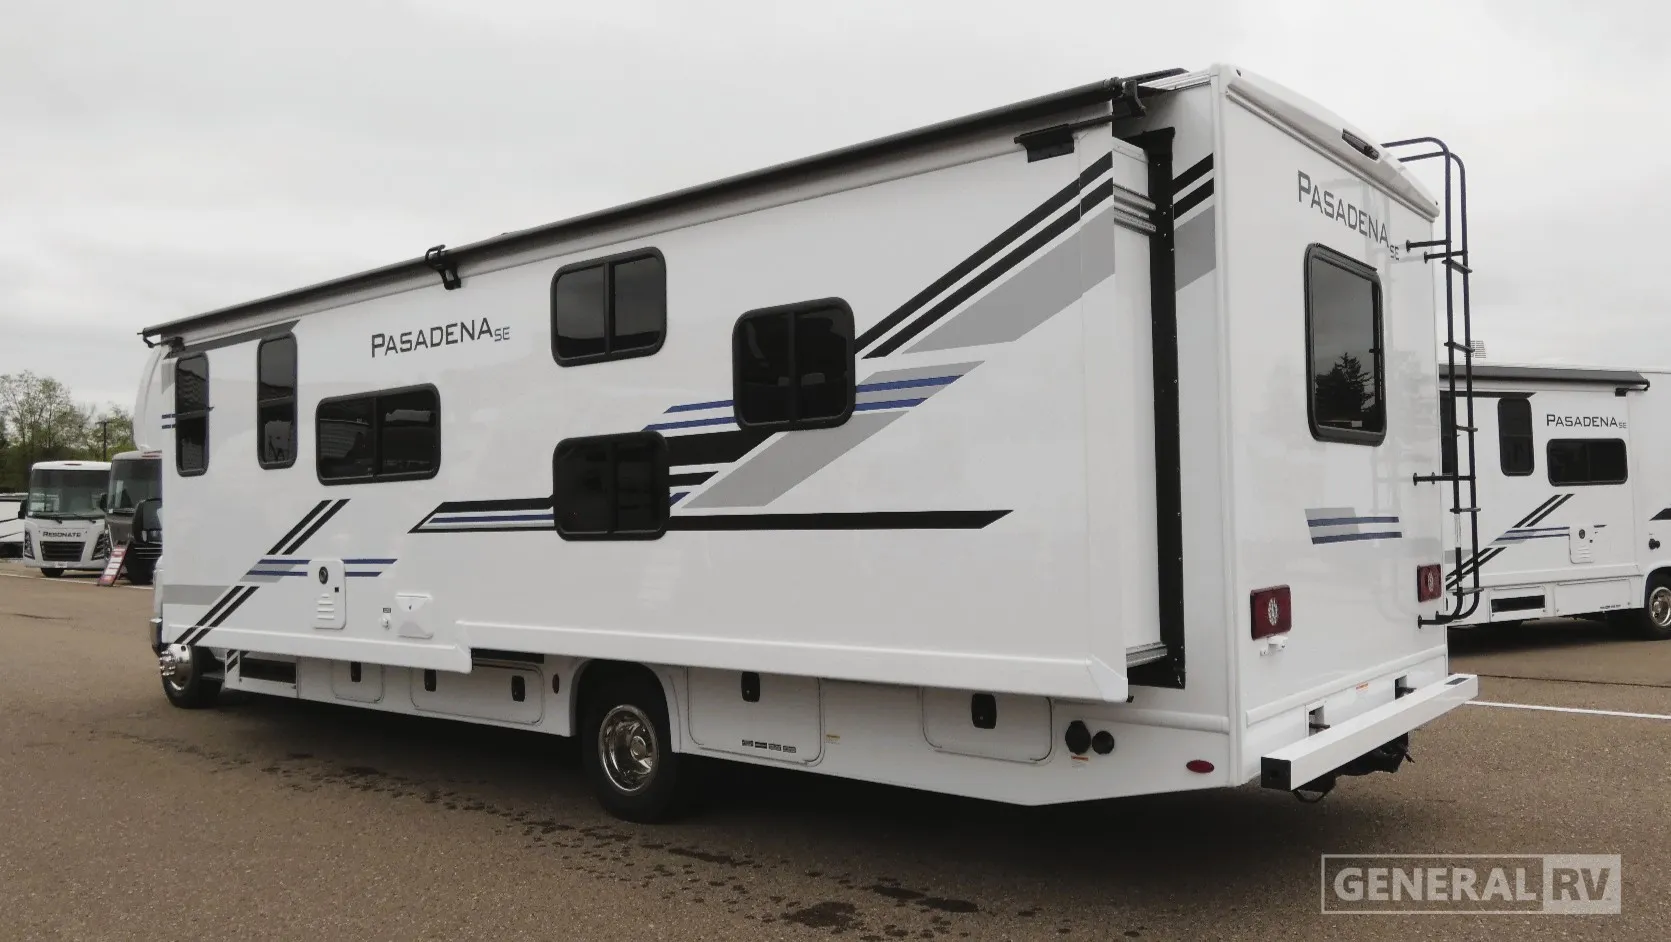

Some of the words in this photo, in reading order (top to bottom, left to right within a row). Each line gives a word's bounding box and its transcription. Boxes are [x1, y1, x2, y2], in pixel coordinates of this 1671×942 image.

[1297, 169, 1389, 249] PASADENA
[1389, 244, 1400, 261] SE
[371, 317, 493, 358] PASADENA
[494, 326, 511, 342] SE
[1546, 413, 1618, 428] PASADENA
